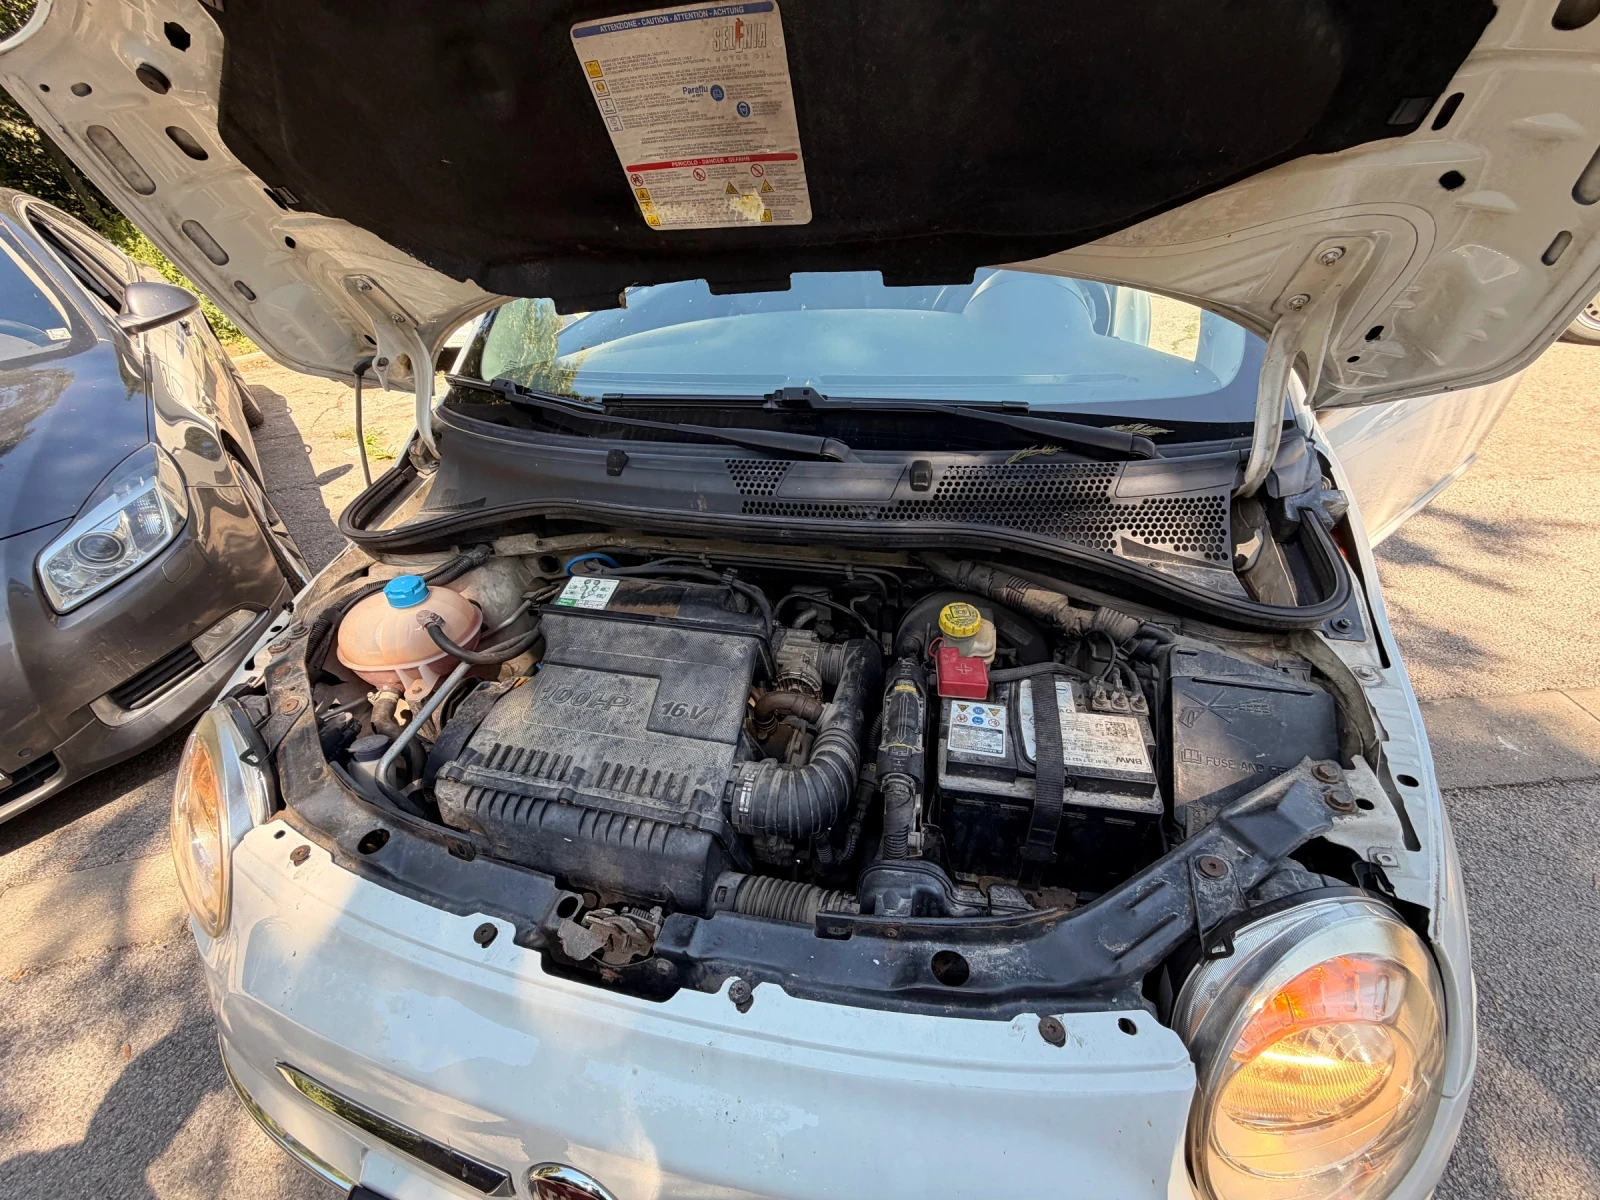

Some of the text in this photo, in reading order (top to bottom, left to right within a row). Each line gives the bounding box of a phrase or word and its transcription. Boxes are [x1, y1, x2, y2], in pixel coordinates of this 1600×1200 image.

[600, 6, 744, 33] ATTENZIONE CAUTION ATTENTION ACHTUNG
[715, 54, 748, 63] MOTOR
[682, 85, 708, 95] Paraflu
[1116, 756, 1143, 765] BMW
[1206, 756, 1236, 770] FUSE
[1241, 761, 1264, 773] AND
